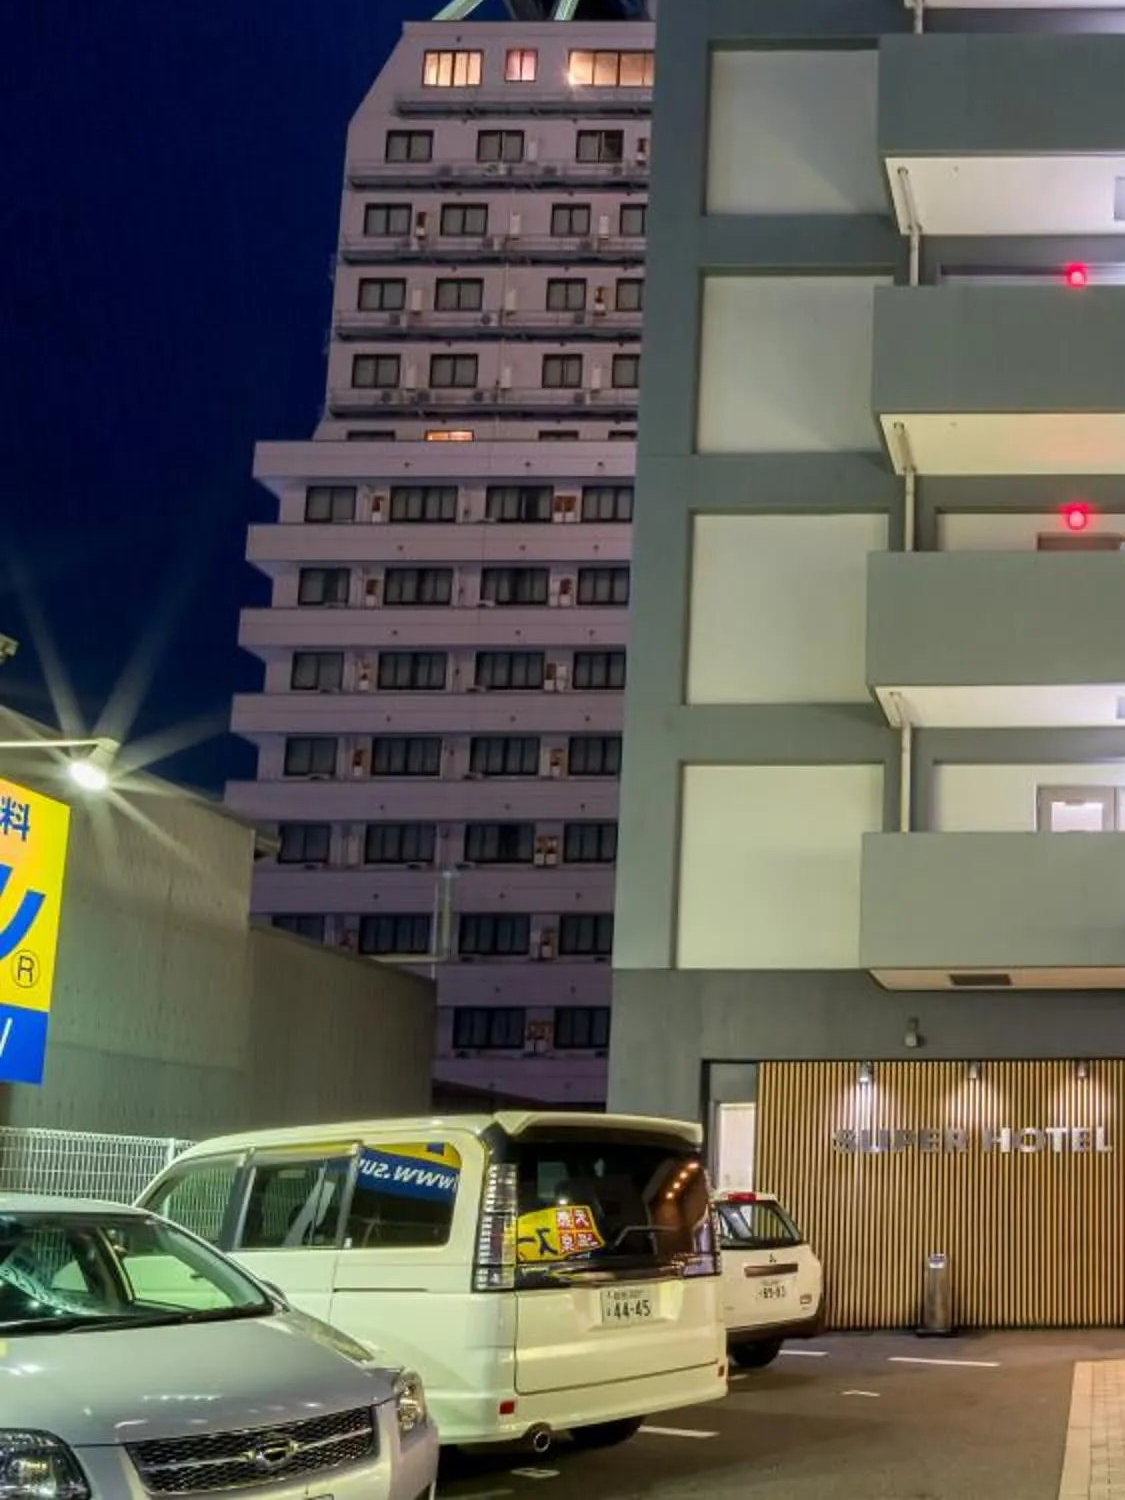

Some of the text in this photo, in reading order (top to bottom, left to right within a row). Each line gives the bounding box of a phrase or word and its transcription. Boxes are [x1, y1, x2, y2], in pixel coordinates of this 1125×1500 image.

[832, 1127, 1113, 1153] SUPER HOTEL
[613, 1299, 652, 1320] 44-45
